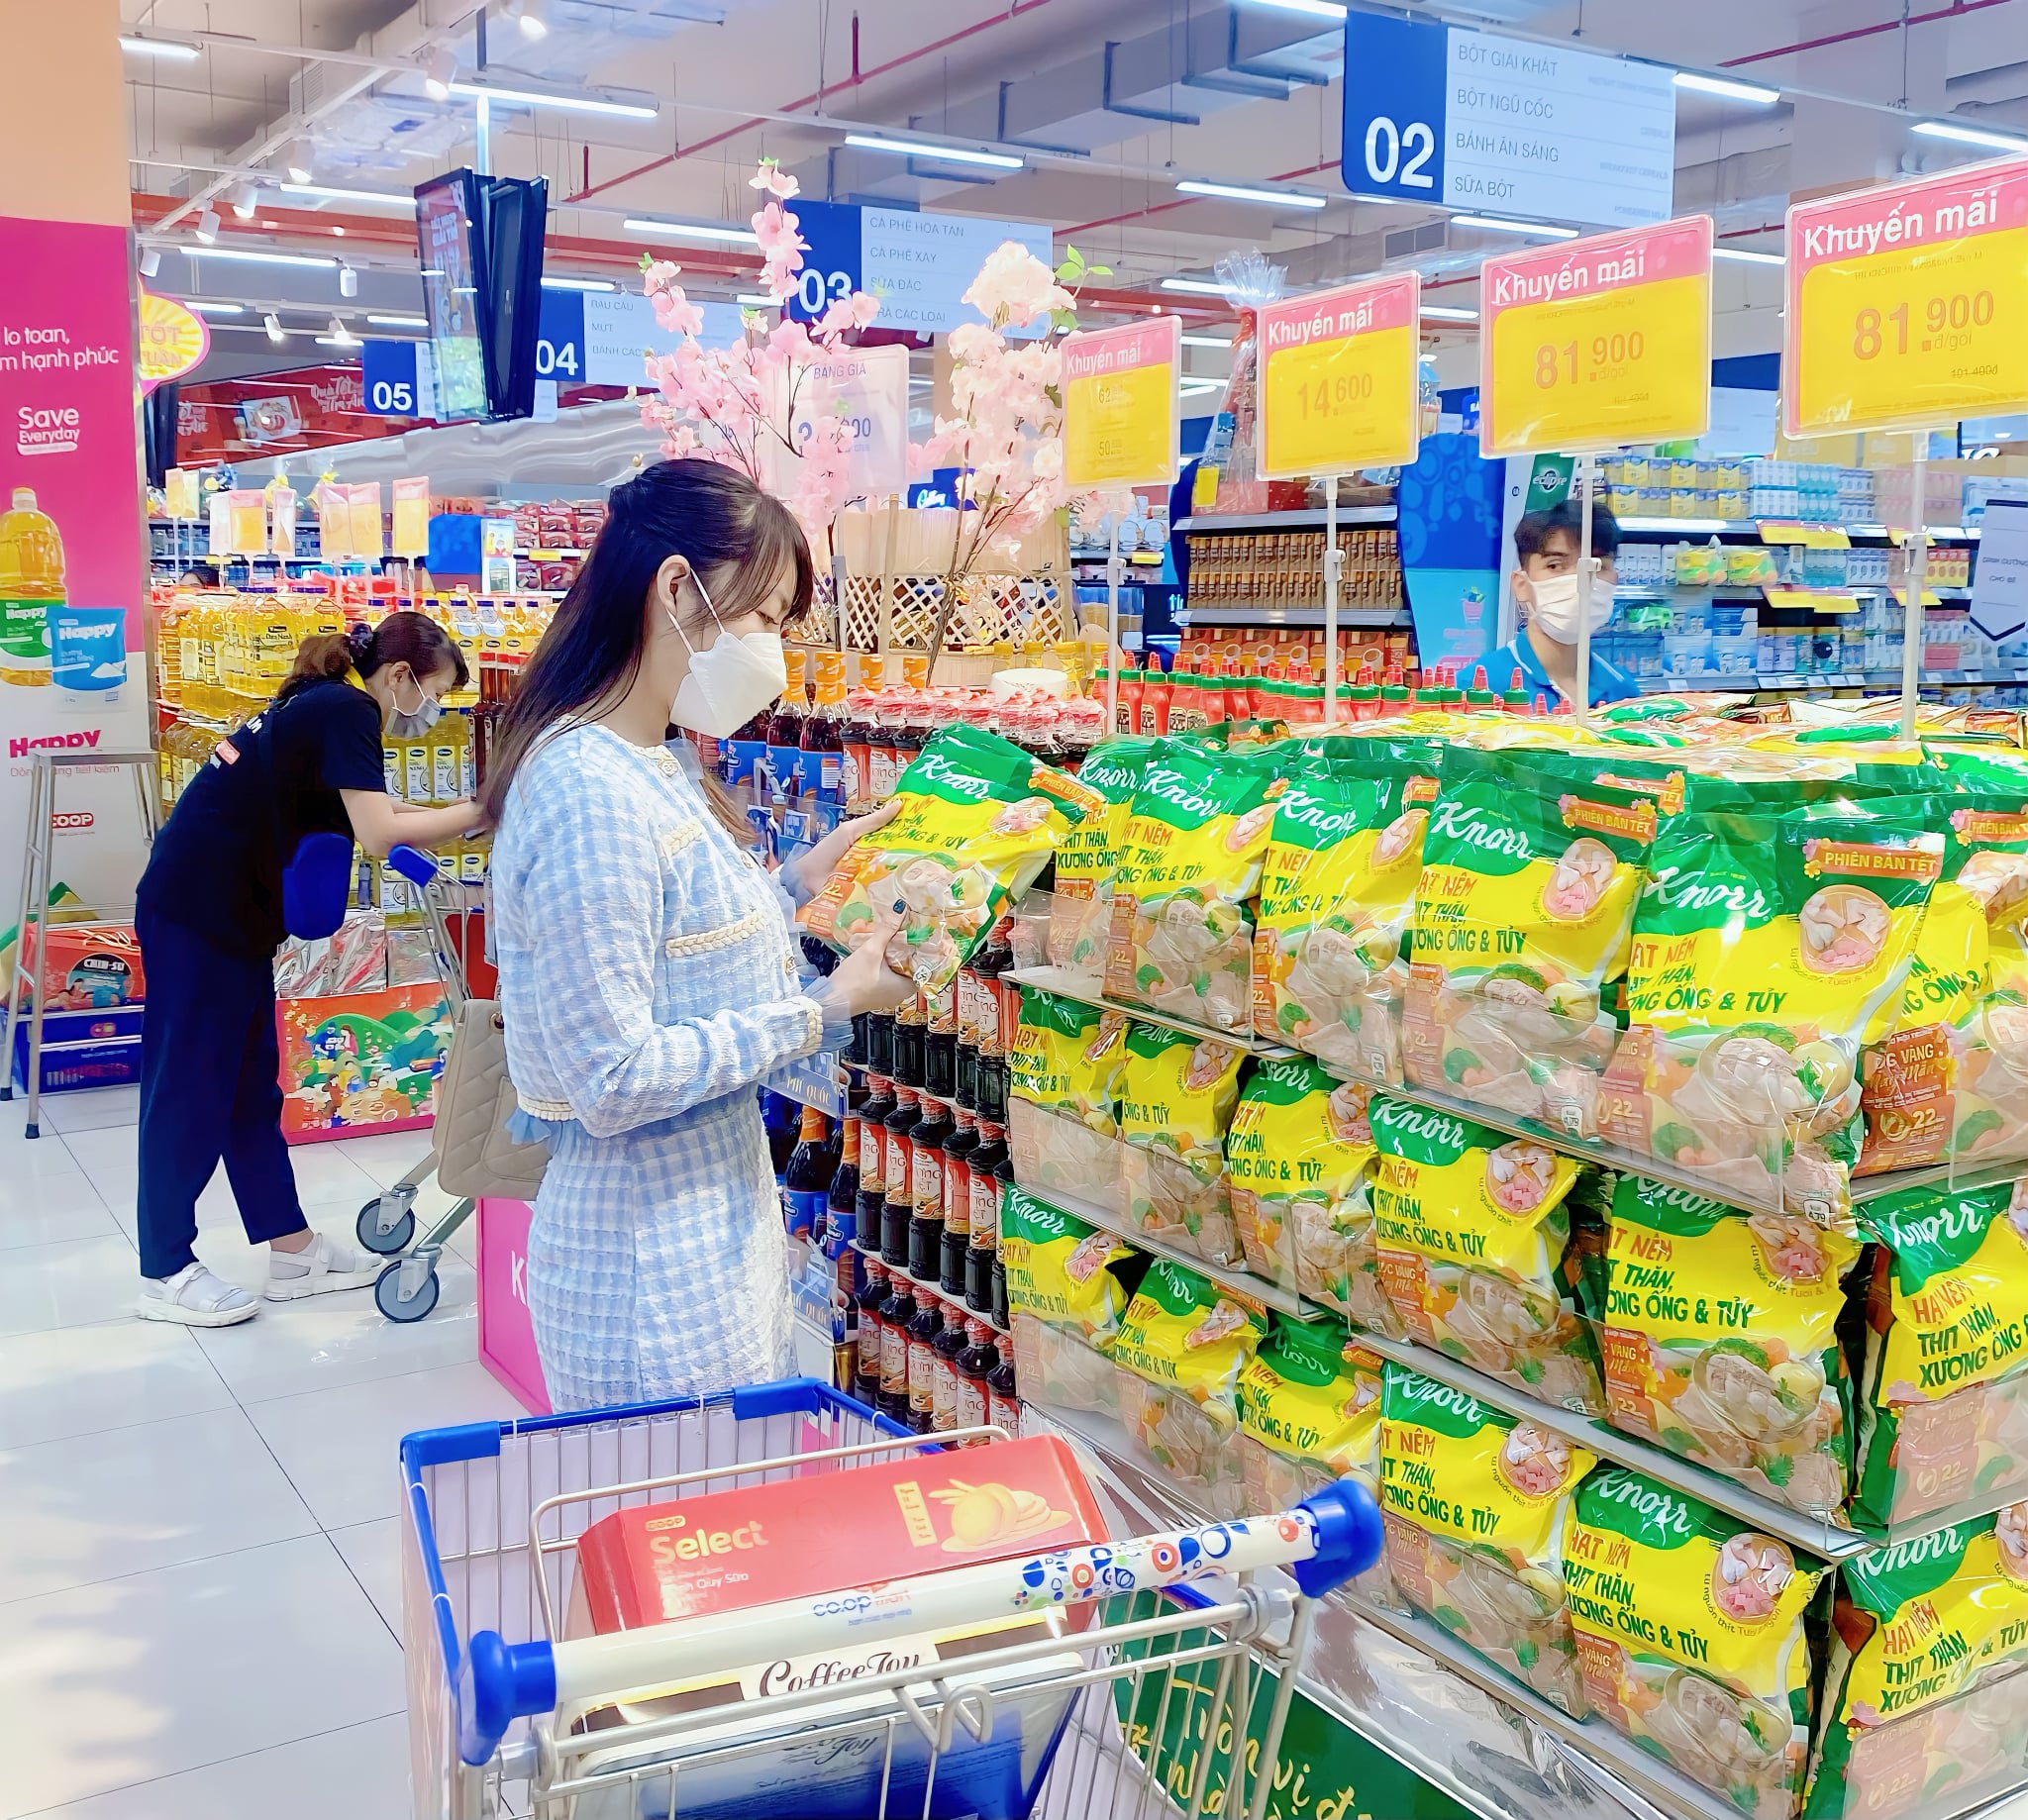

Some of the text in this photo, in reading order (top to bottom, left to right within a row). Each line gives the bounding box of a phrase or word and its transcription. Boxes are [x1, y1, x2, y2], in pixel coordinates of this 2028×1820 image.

[1459, 43, 1487, 68] BỘT
[1522, 55, 1560, 77] KHÁT
[1458, 87, 1486, 110] BỘT
[1524, 97, 1554, 119] CỐC
[1365, 116, 1435, 189] 02
[1456, 130, 1560, 162] BÁNH ĂN SÁNG
[1455, 173, 1515, 202] SỮA BỘT
[869, 215, 886, 229] CÀ
[889, 217, 912, 232] PHÊ
[943, 225, 964, 238] TAN
[1804, 189, 1998, 259] Khuyến mãi
[870, 245, 937, 263] CÀ PHÊ XAY
[798, 268, 853, 314] 03
[1493, 250, 1645, 305] Khuyến mãi
[875, 305, 892, 318] RÀ
[1268, 300, 1373, 346] Khuyến mãi
[1854, 290, 1994, 361] 81.900
[4, 327, 70, 347] lo toan,
[22, 350, 70, 373] hạnh
[74, 346, 120, 371] phúc
[536, 339, 579, 376] 04
[1066, 341, 1142, 376] Khuyến mãi
[1536, 331, 1645, 390] 81.900
[372, 381, 412, 412] 05
[17, 407, 80, 430] Save
[19, 428, 80, 445] Everyday
[6, 606, 48, 620] Happy
[59, 623, 117, 641] Happy
[10, 766, 34, 777] Dòn
[915, 754, 991, 800] Knorr
[1077, 756, 1138, 789] Knorr
[1144, 769, 1226, 817] Knorr
[1144, 822, 1173, 847] NÊM
[1432, 802, 1536, 860] Knorr
[1574, 807, 1652, 835] PHIÊN BẢN TẾT
[1824, 851, 1936, 874] PHIÊN BẢN TẾT
[1442, 869, 1477, 897] NÊM
[1644, 865, 1773, 921] Knorr
[1448, 923, 1528, 955] ỐNG TỦY
[1664, 936, 1698, 967] NÊM
[1666, 980, 1787, 1014] ỐNG TỦY
[1900, 1043, 1934, 1064] VÀNG
[1373, 1096, 1468, 1150] Knorr
[1612, 1099, 1633, 1116] 22
[1911, 1108, 1937, 1129] 22
[1389, 1164, 1418, 1189] NÊM
[1009, 1192, 1066, 1235] Knorr
[1891, 1201, 1984, 1250] Knorr
[1413, 1223, 1487, 1259] ỐNG TỦY
[1631, 1233, 1673, 1263] NÊM
[1622, 1265, 1674, 1294] THĂN,
[1048, 1296, 1056, 1313] &
[1646, 1287, 1755, 1329] ỐNG & TỦY
[1610, 1341, 1637, 1362] VÀNG
[1918, 1324, 1960, 1358] THỊT
[1154, 1357, 1162, 1372] &
[1919, 1329, 2021, 1389] XƯƠNG ỐNG
[1249, 1364, 1283, 1388] NÊM
[1395, 1370, 1484, 1424] Knorr
[1618, 1397, 1637, 1413] 22
[1399, 1427, 1436, 1459] NÊM
[1400, 1459, 1436, 1492] THĂN,
[1491, 1469, 1513, 1499] nguồn
[1940, 1461, 1964, 1479] 22
[1417, 1488, 1503, 1537] ỐNG & TỦY
[1588, 1468, 1692, 1537] Knorr
[650, 1520, 769, 1566] Select
[1856, 1528, 1965, 1578] Knorr
[1593, 1571, 1636, 1612] THĂN,
[1616, 1597, 1710, 1664] ỐNG & TỦY
[1882, 1622, 1911, 1658] HẠT
[1584, 1648, 1611, 1669] VÀNG
[1882, 1630, 1973, 1685] THỊT THĂN,
[1879, 1672, 1948, 1714] XƯƠNG
[1891, 1772, 1911, 1794] 22
